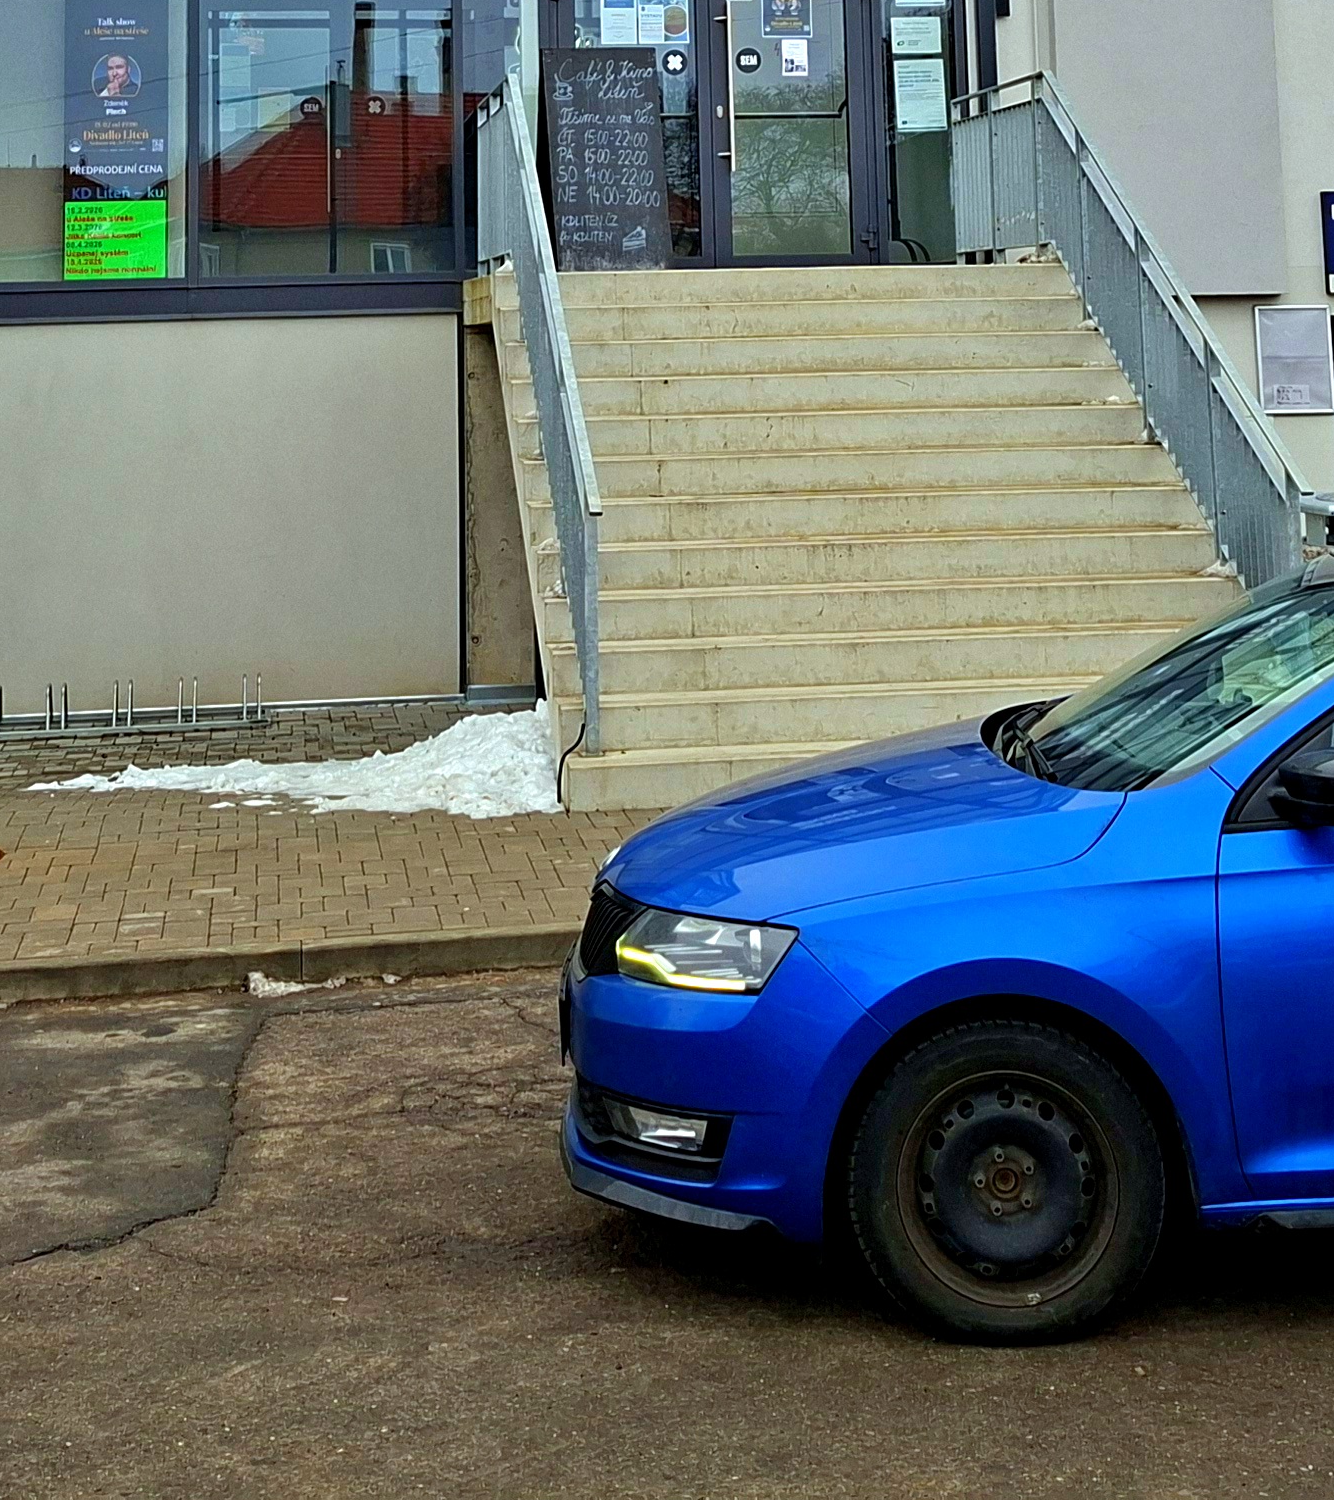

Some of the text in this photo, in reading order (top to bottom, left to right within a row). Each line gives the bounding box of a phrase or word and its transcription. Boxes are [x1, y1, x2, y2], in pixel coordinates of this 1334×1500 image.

[97, 17, 136, 26] Talk show
[740, 54, 758, 66] SEM
[559, 58, 653, 89] Café & Kino
[598, 80, 645, 99] Liteň
[303, 103, 319, 112] SEM
[83, 129, 149, 140] Divadlo Liteň
[70, 163, 163, 175] PŘEDPRODEJNÍ CENA
[556, 166, 578, 183] SO
[72, 187, 91, 199] KD
[96, 186, 130, 199] Liteň
[557, 186, 578, 202] NE
